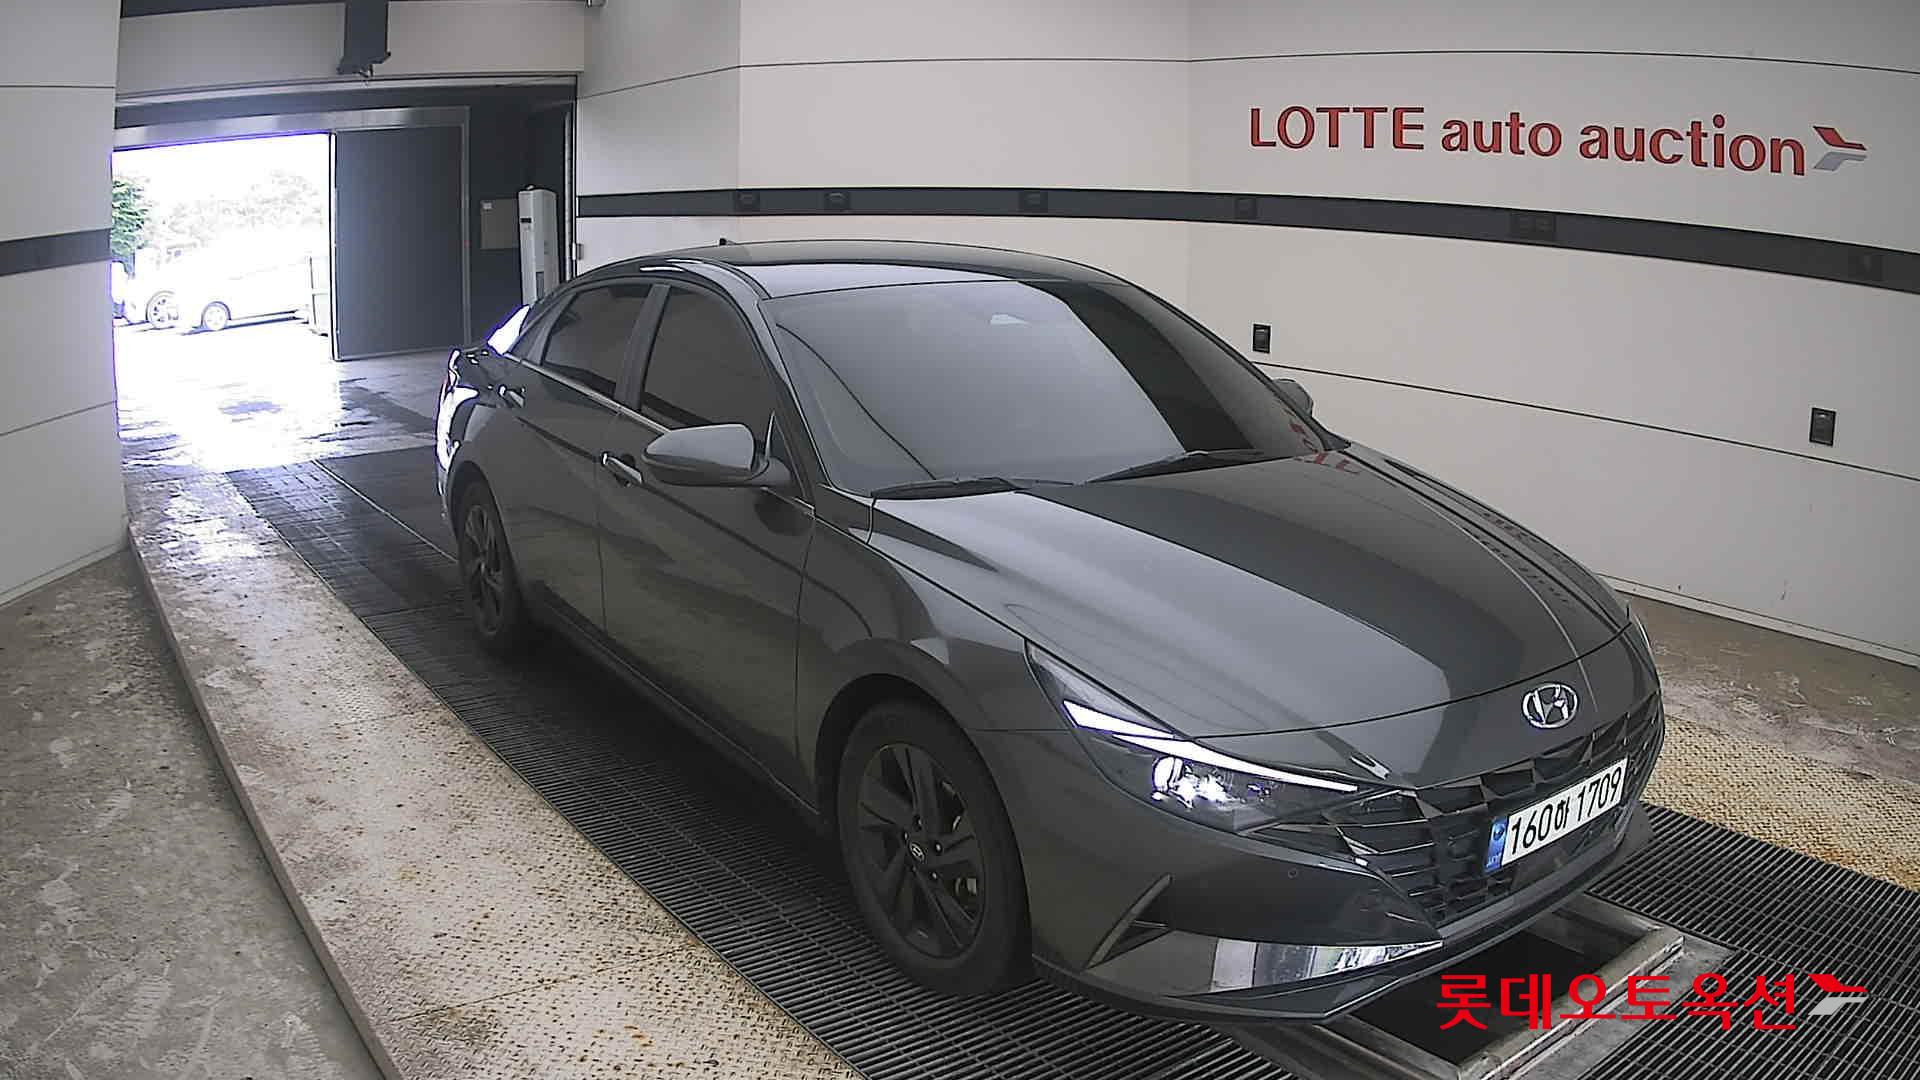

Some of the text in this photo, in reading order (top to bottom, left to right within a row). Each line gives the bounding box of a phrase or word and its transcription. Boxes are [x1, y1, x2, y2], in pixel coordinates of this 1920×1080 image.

[1249, 105, 1806, 177] LOTTE auto auction
[1510, 766, 1623, 855] 160하 1709
